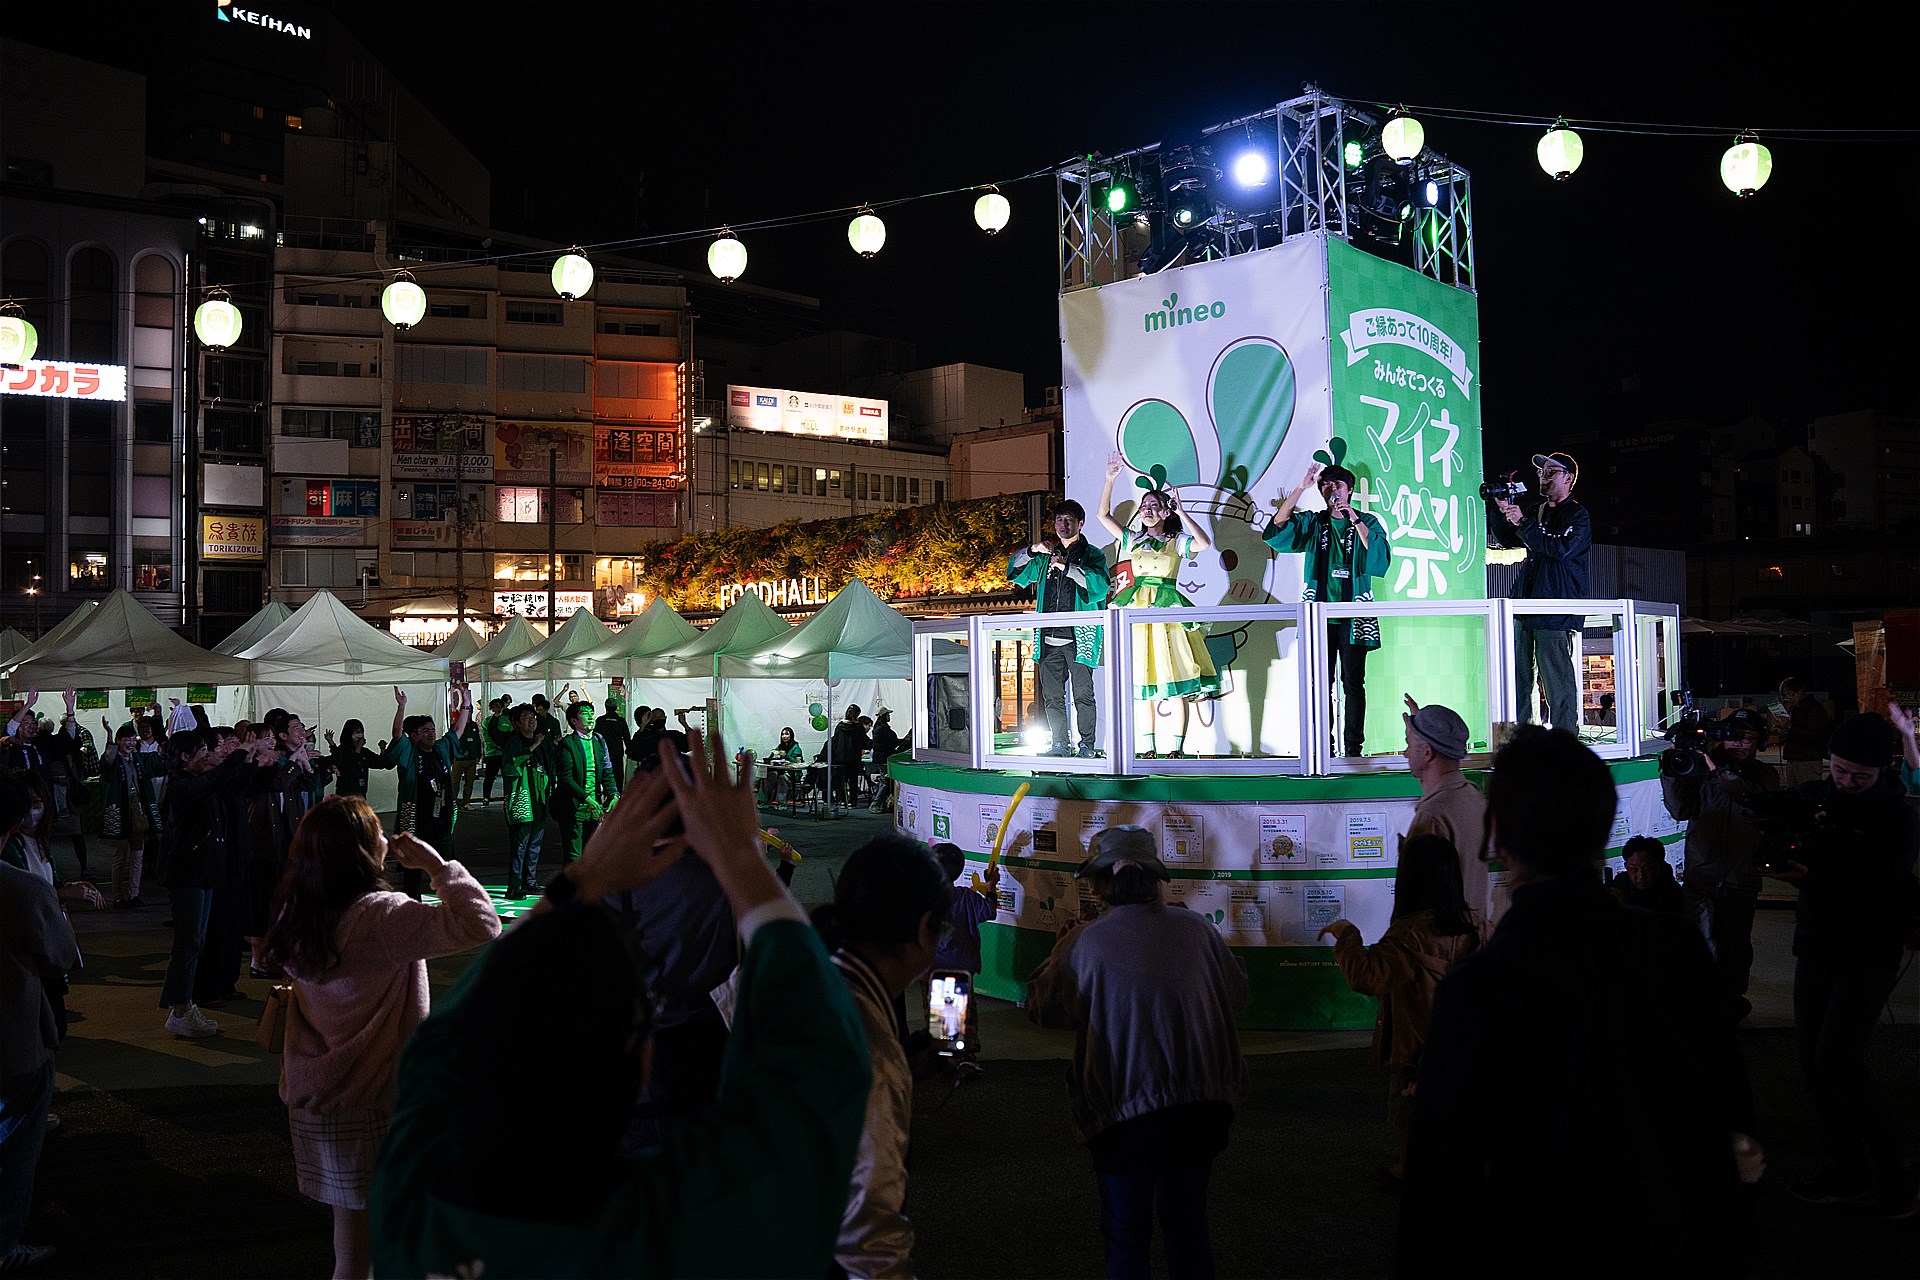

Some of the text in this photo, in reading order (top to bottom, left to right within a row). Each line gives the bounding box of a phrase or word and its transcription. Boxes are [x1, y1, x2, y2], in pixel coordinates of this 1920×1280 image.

[233, 6, 311, 40] KEIHAN
[1144, 292, 1226, 333] mineo
[1365, 315, 1454, 363] ご縁あって10周年!
[0, 365, 100, 396] ンカラ
[1374, 359, 1446, 399] みんなでつくる
[1359, 394, 1465, 488] マイネ
[335, 489, 378, 508] 麻雀
[624, 478, 676, 488] 1200~24:00
[309, 495, 327, 506] 3F
[208, 521, 257, 542] 鳥貴族
[208, 544, 257, 554] TORIKIZOKU
